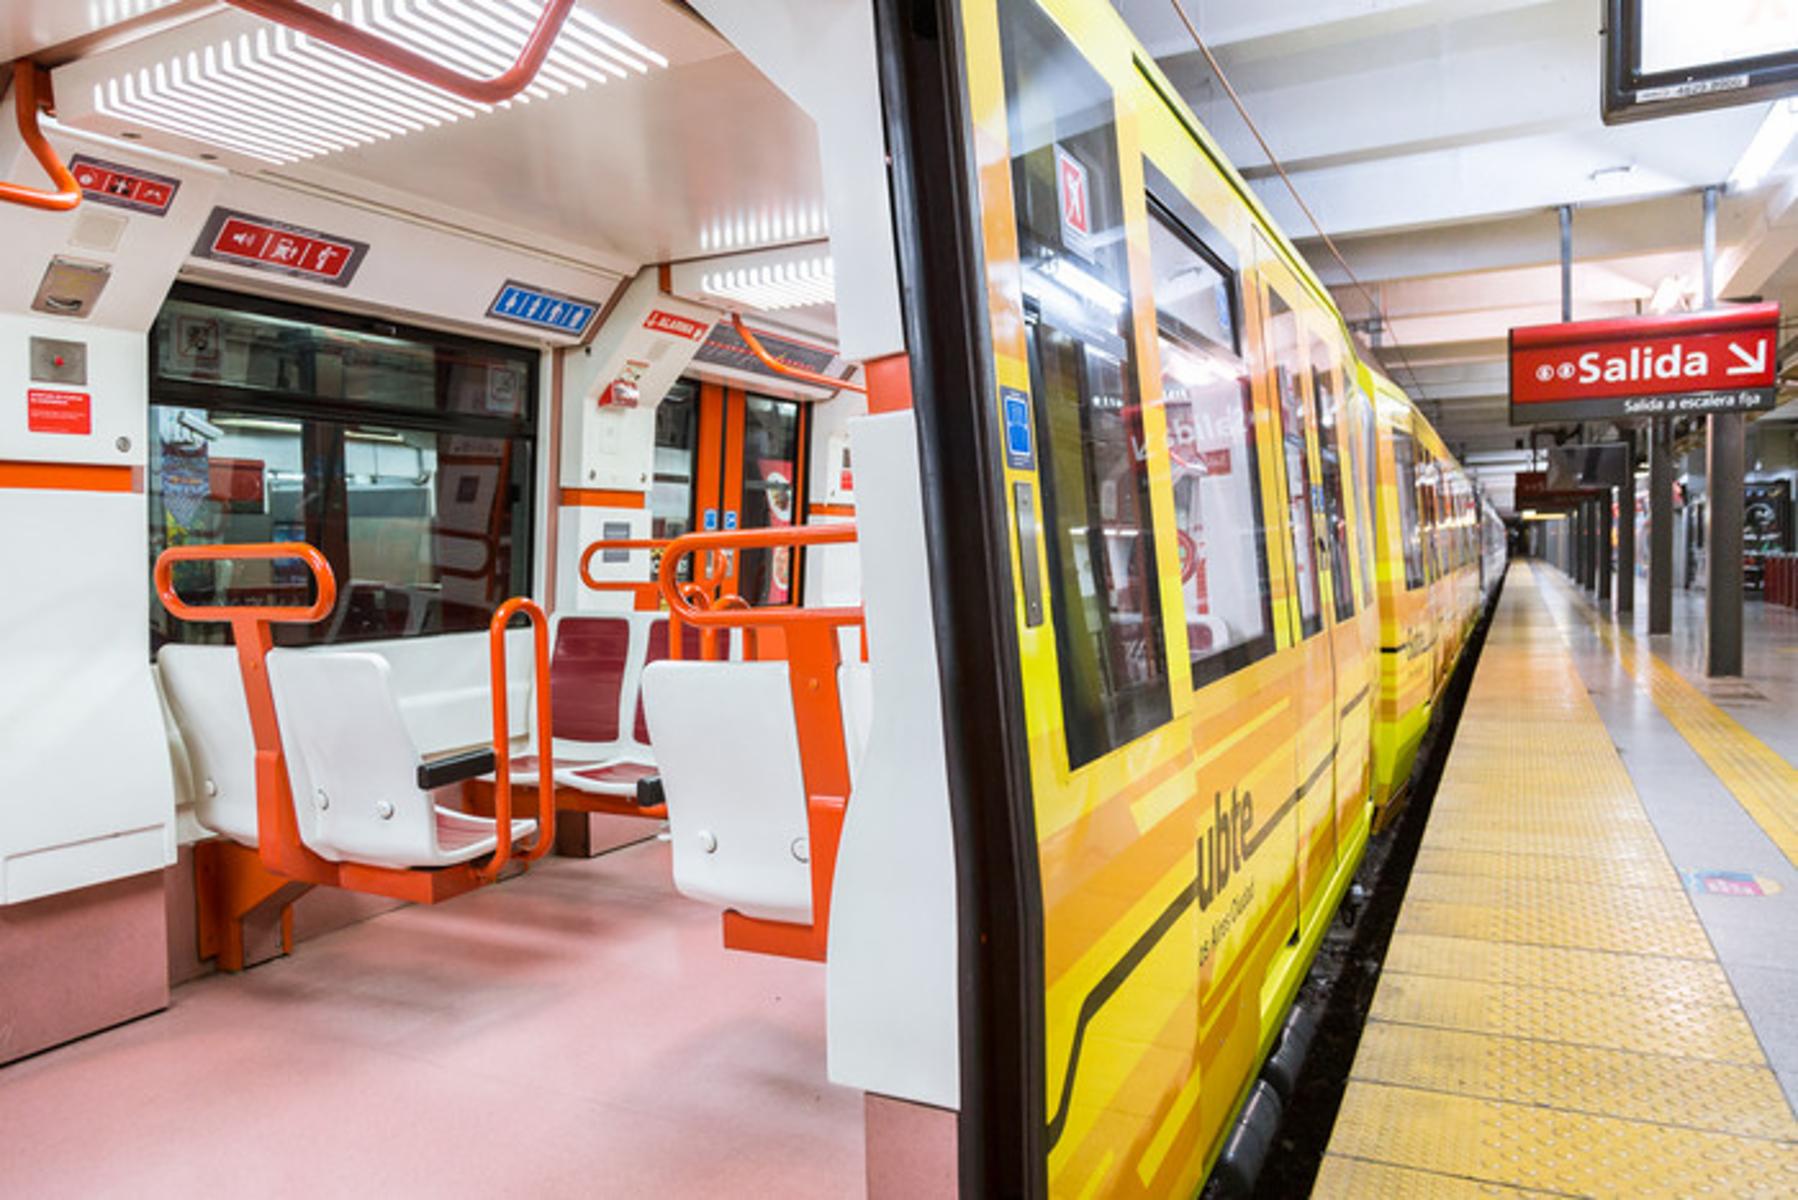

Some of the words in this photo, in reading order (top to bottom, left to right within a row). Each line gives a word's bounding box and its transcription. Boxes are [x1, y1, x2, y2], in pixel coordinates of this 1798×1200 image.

[1578, 344, 1708, 384] Salida
[1624, 399, 1664, 413] Salida
[1667, 400, 1676, 410] a
[1679, 394, 1735, 409] escalera
[1739, 391, 1760, 407] fija
